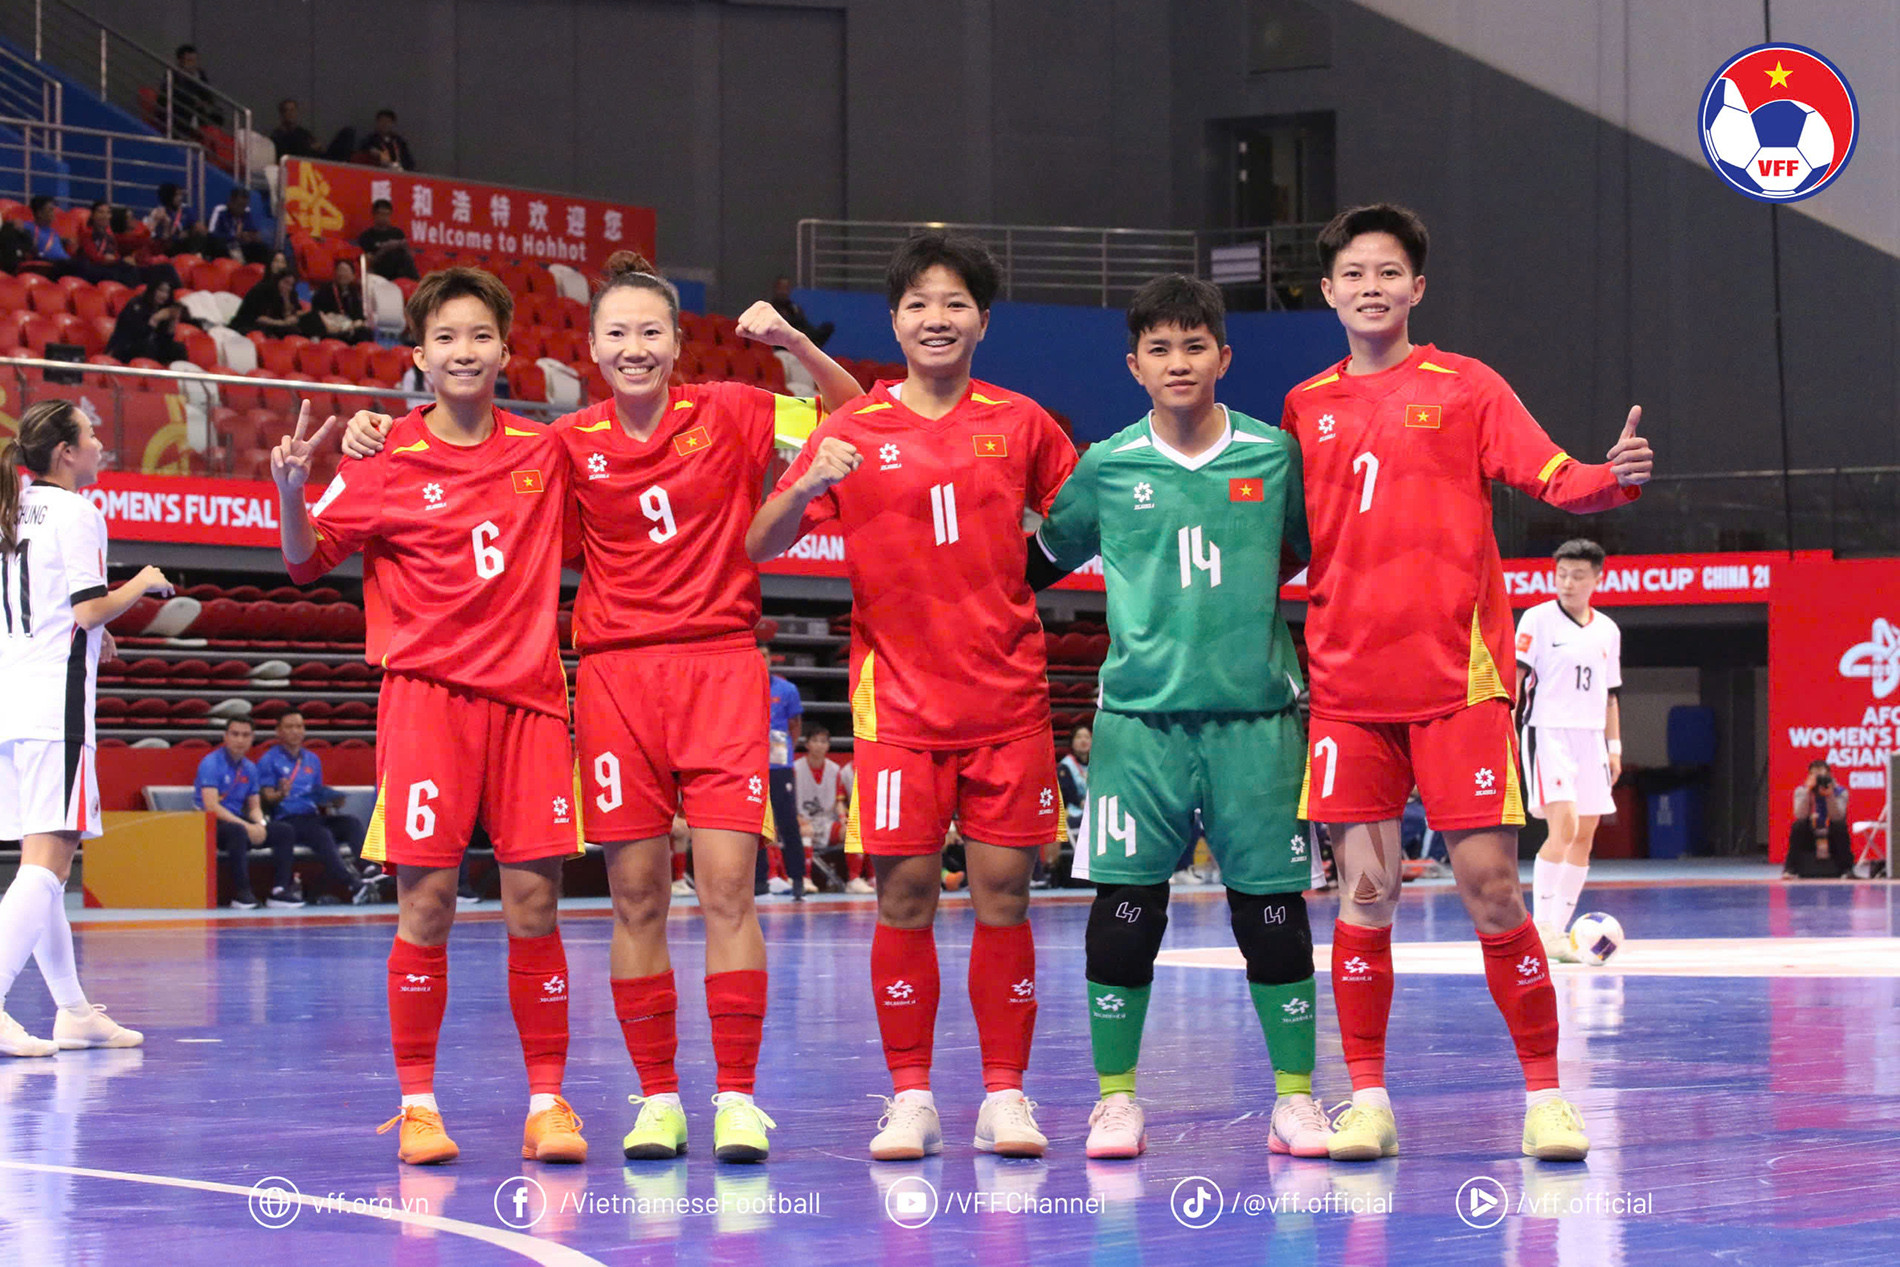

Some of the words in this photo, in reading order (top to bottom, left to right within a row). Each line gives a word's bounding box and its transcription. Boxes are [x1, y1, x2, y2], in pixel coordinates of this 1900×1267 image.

[411, 219, 492, 250] Welcome
[499, 231, 516, 252] to
[522, 234, 587, 262] Hohhot
[185, 496, 278, 528] FUTSAL
[1353, 451, 1379, 514] 7
[639, 485, 677, 544] 9
[930, 482, 959, 547] 11
[472, 520, 504, 580] 6
[1178, 525, 1221, 589] 14
[1643, 567, 1695, 592] CUP
[1702, 565, 1750, 590] CHINA
[1575, 665, 1592, 691] 13
[1314, 736, 1338, 799] 7
[1788, 727, 1893, 748] WOMEN'S
[1825, 747, 1890, 767] ASIAN
[405, 779, 439, 840] 6
[594, 751, 623, 813] 9
[875, 769, 902, 830] 11
[1097, 795, 1137, 858] 14
